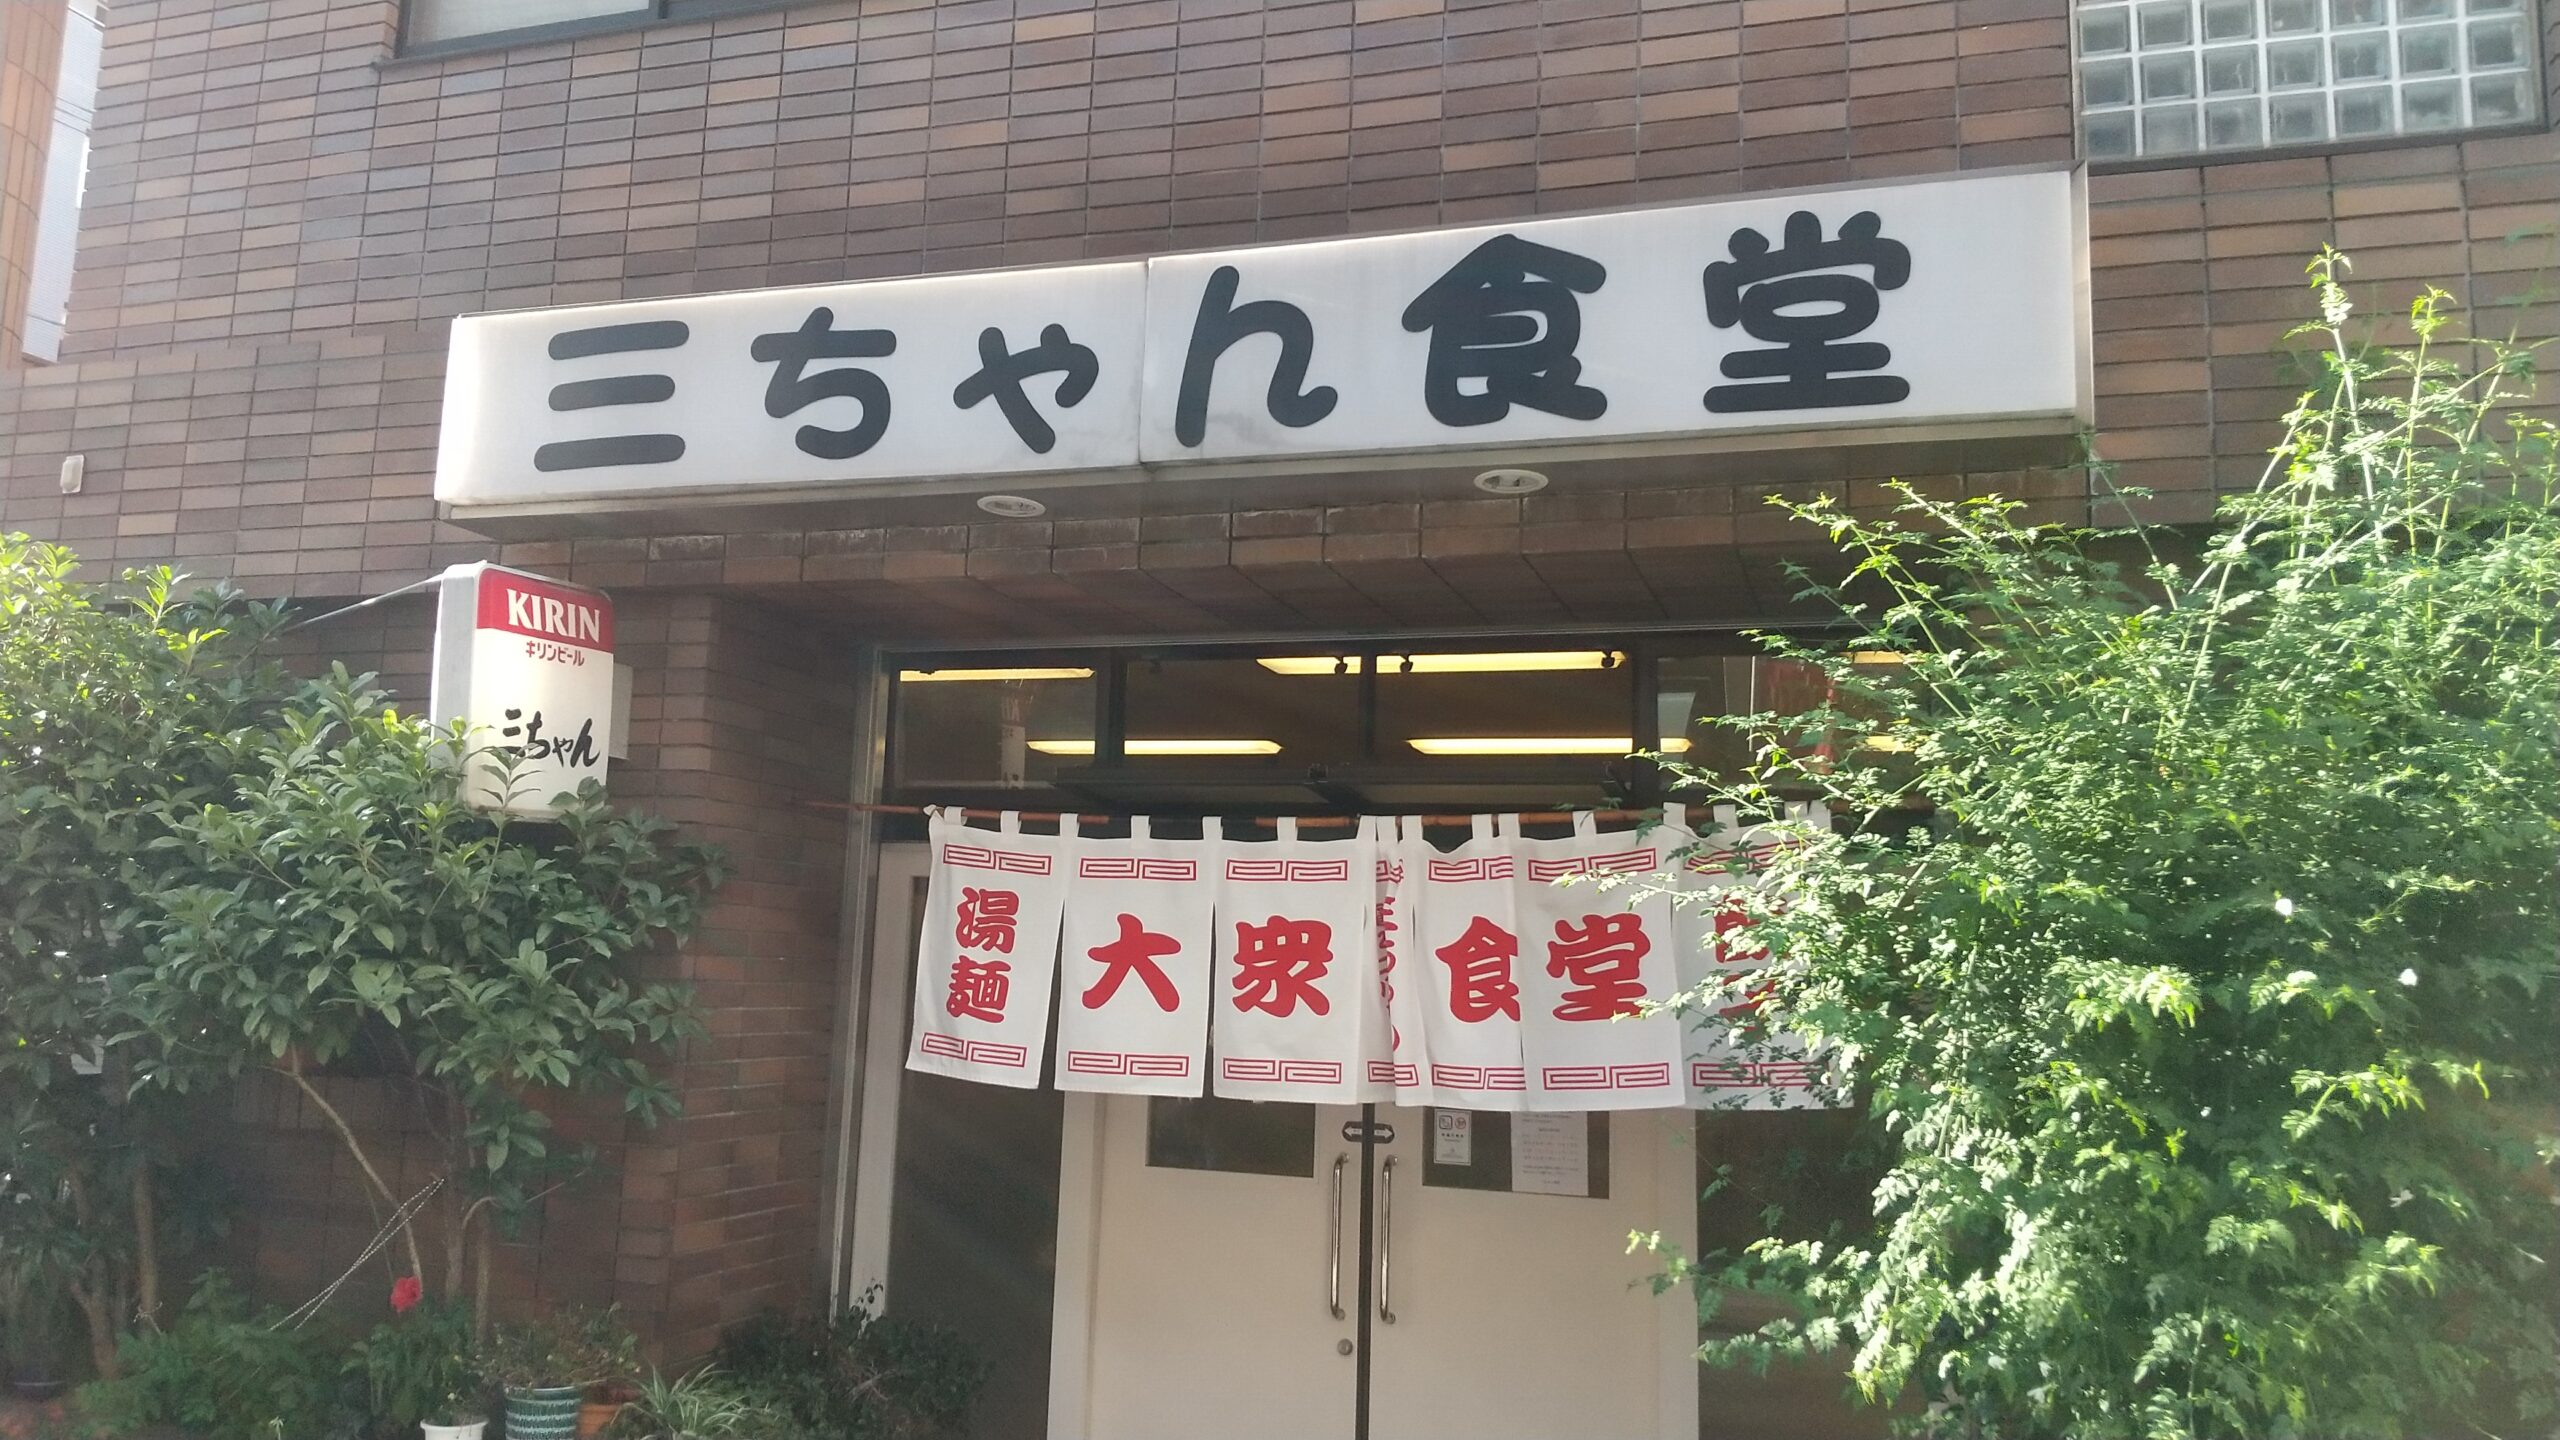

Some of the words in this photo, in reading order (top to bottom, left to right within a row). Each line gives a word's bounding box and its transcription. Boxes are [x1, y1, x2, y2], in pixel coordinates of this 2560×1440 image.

[534, 210, 1911, 473] 三ちゃん食堂
[506, 588, 600, 643] KIRIN
[526, 640, 585, 667] キリンビール
[503, 708, 600, 768] 三ちゃん
